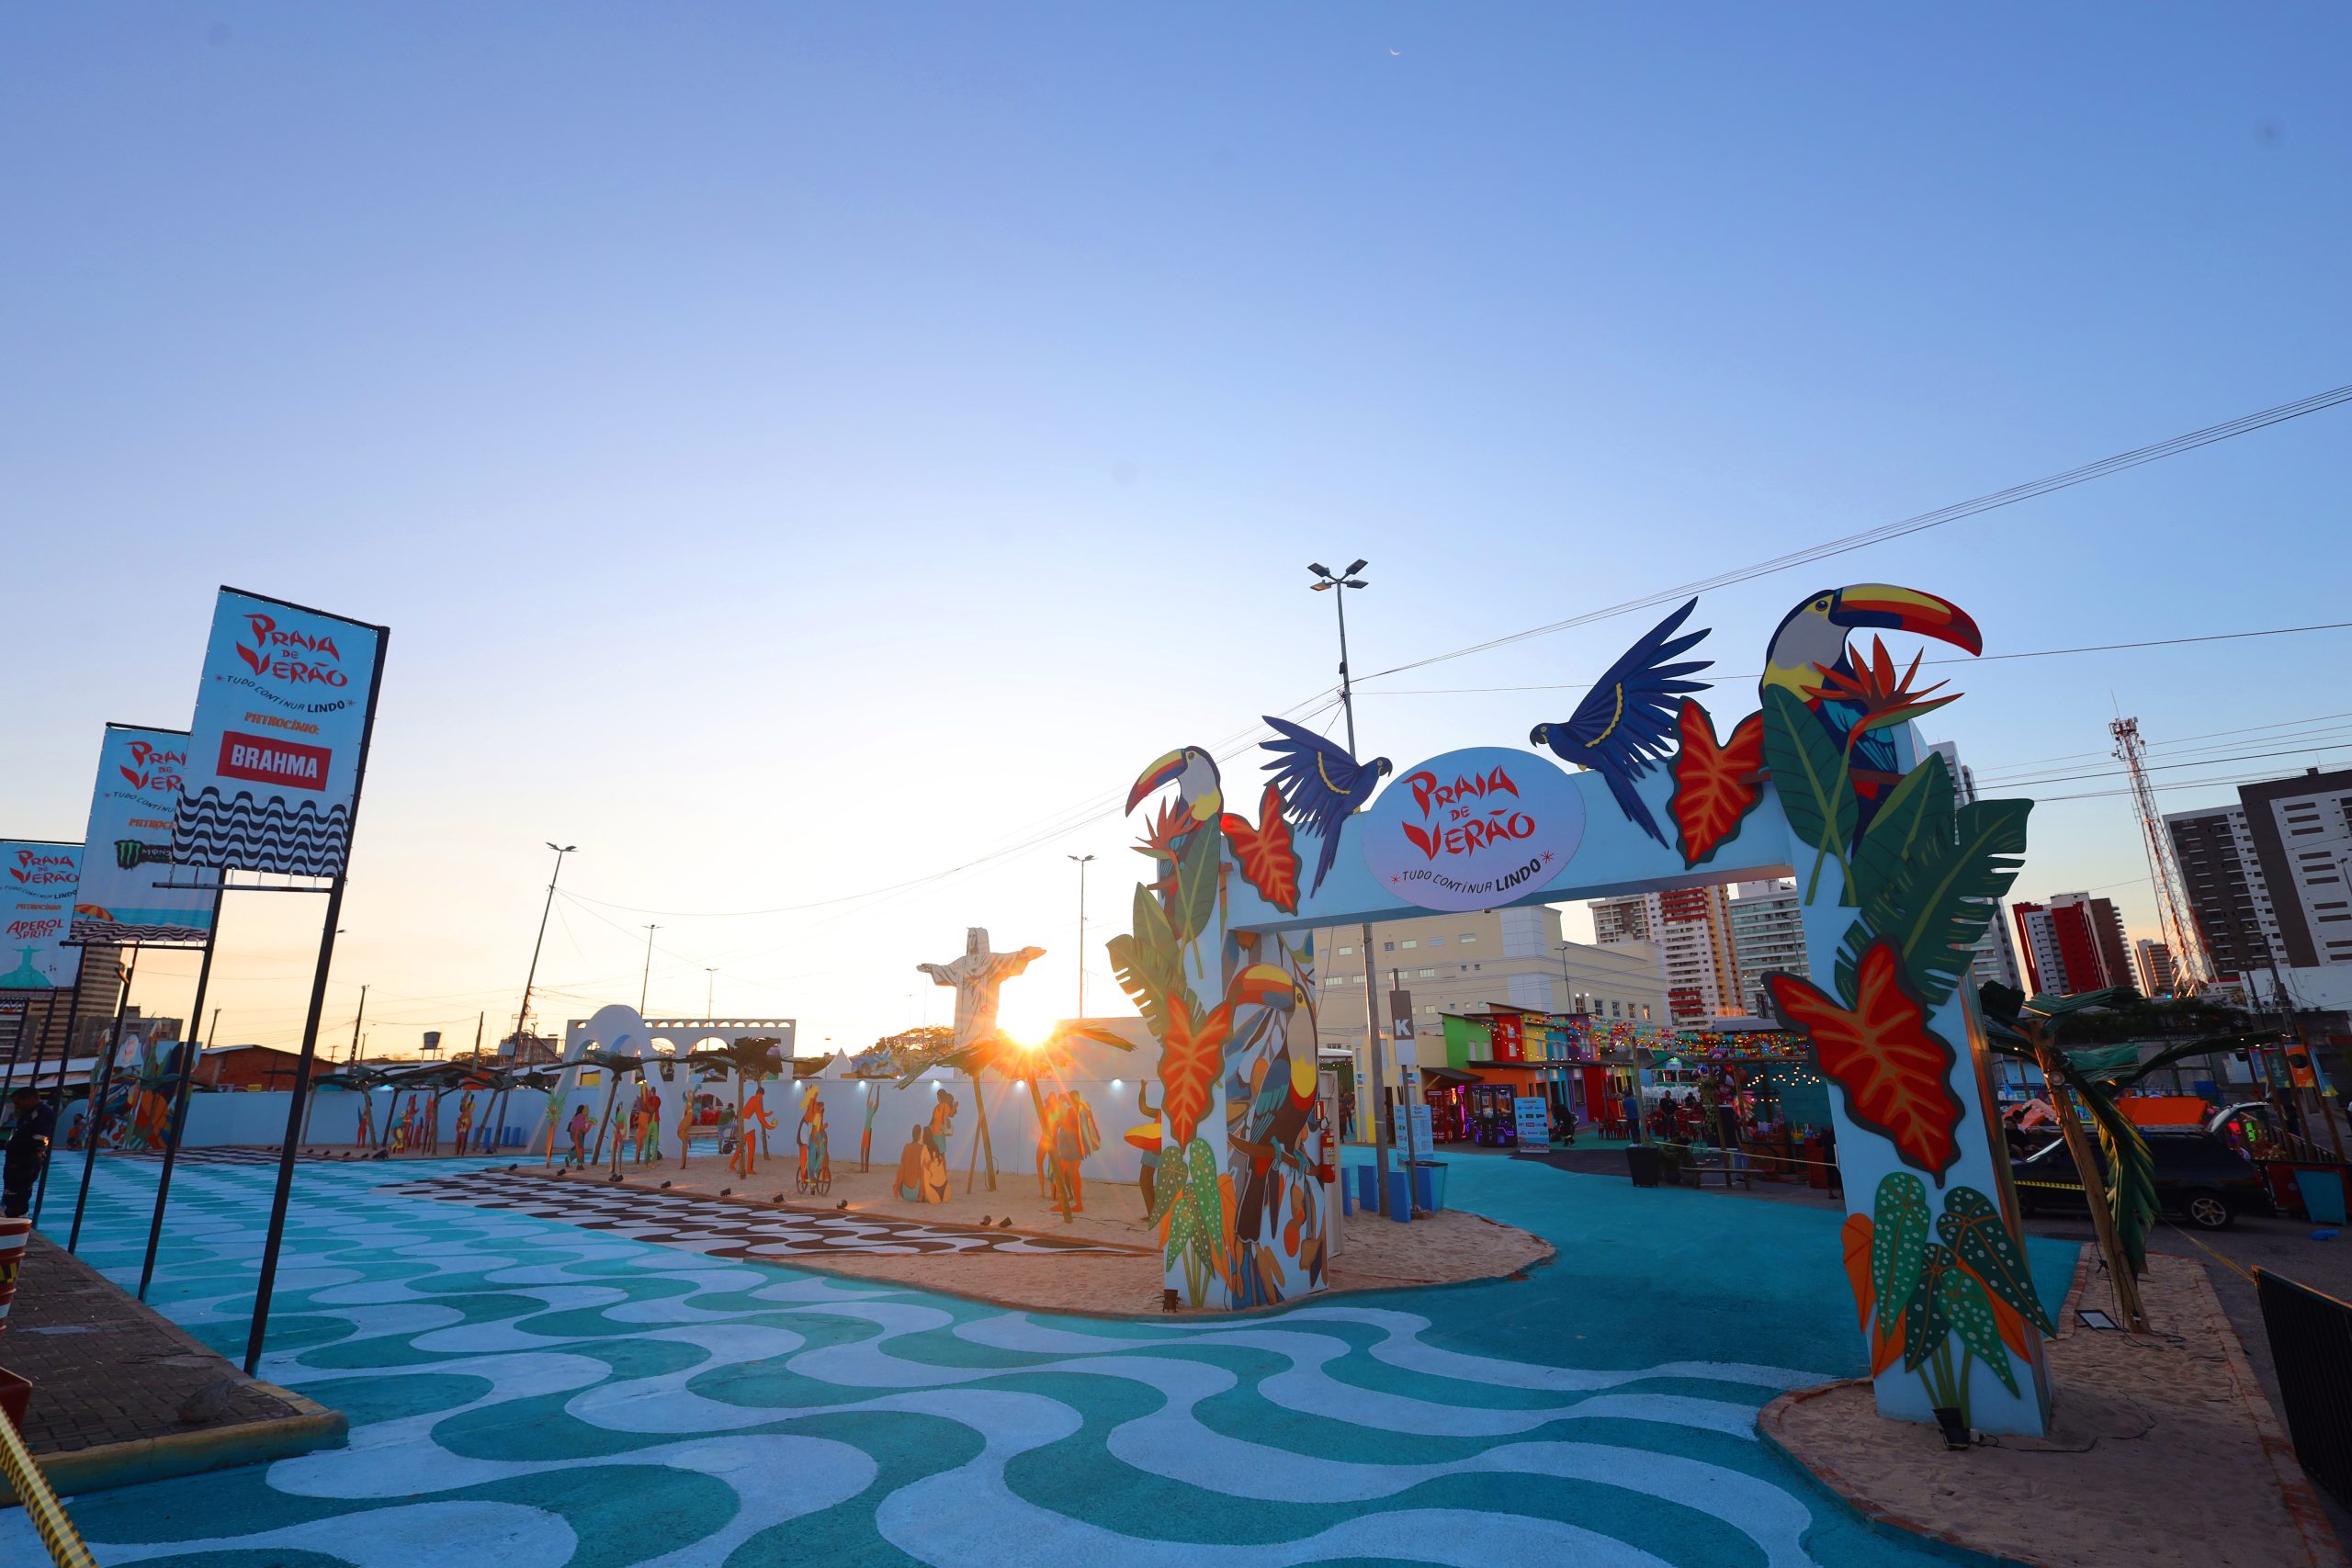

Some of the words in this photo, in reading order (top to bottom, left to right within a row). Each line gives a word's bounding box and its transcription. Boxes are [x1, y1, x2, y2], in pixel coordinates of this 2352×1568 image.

[243, 614, 340, 661] PRAIA
[236, 640, 348, 687] VERÃO
[281, 649, 300, 659] DE
[227, 675, 255, 688] TUDO
[307, 700, 345, 713] LINDO
[125, 740, 187, 768] PRAI
[231, 744, 318, 779] BRAHMA
[119, 764, 182, 794] VER
[1401, 764, 1520, 821] PRAIA
[113, 791, 138, 801] TUDO
[1451, 806, 1470, 822] DE
[1401, 808, 1535, 862] VERÃO
[15, 851, 74, 869] PRAIA
[9, 867, 79, 885] VERÃO
[1403, 870, 1431, 881] TUDO
[1496, 858, 1542, 892] LINDO
[6, 919, 64, 934] APEROL
[15, 930, 53, 940] SPRITZ
[1395, 1020, 1411, 1036] K
